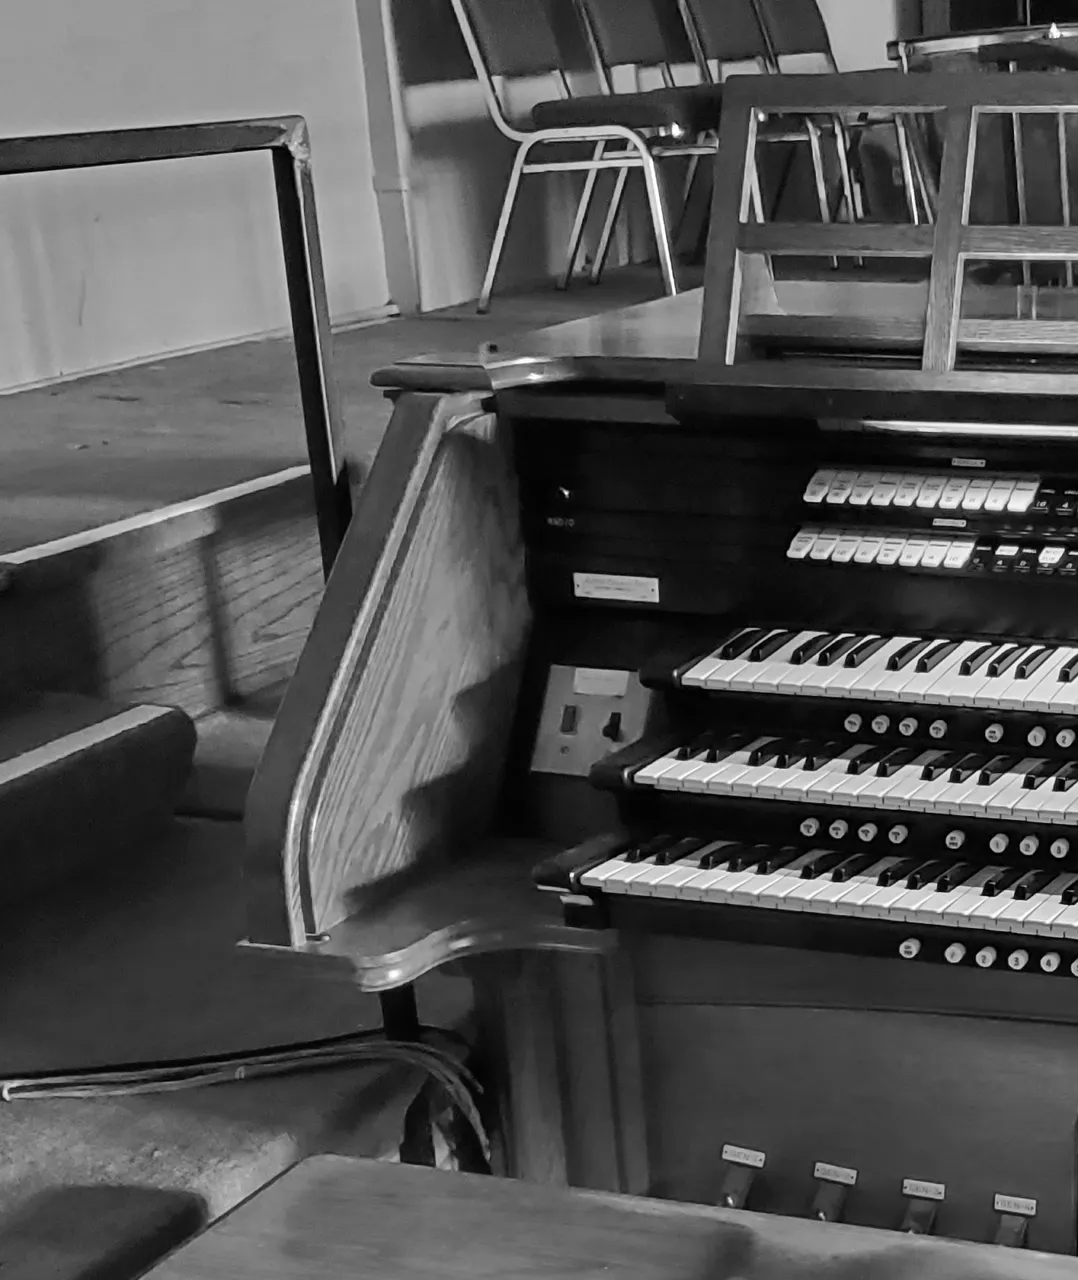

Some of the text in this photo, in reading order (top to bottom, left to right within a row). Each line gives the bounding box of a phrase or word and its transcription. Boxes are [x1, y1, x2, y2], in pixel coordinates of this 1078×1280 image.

[1033, 734, 1037, 744] 1
[1061, 735, 1067, 744] 2
[996, 841, 999, 850] 1
[1024, 843, 1031, 852] 2
[981, 954, 987, 964] 2
[1014, 957, 1020, 966] 3
[1045, 959, 1052, 968] 4
